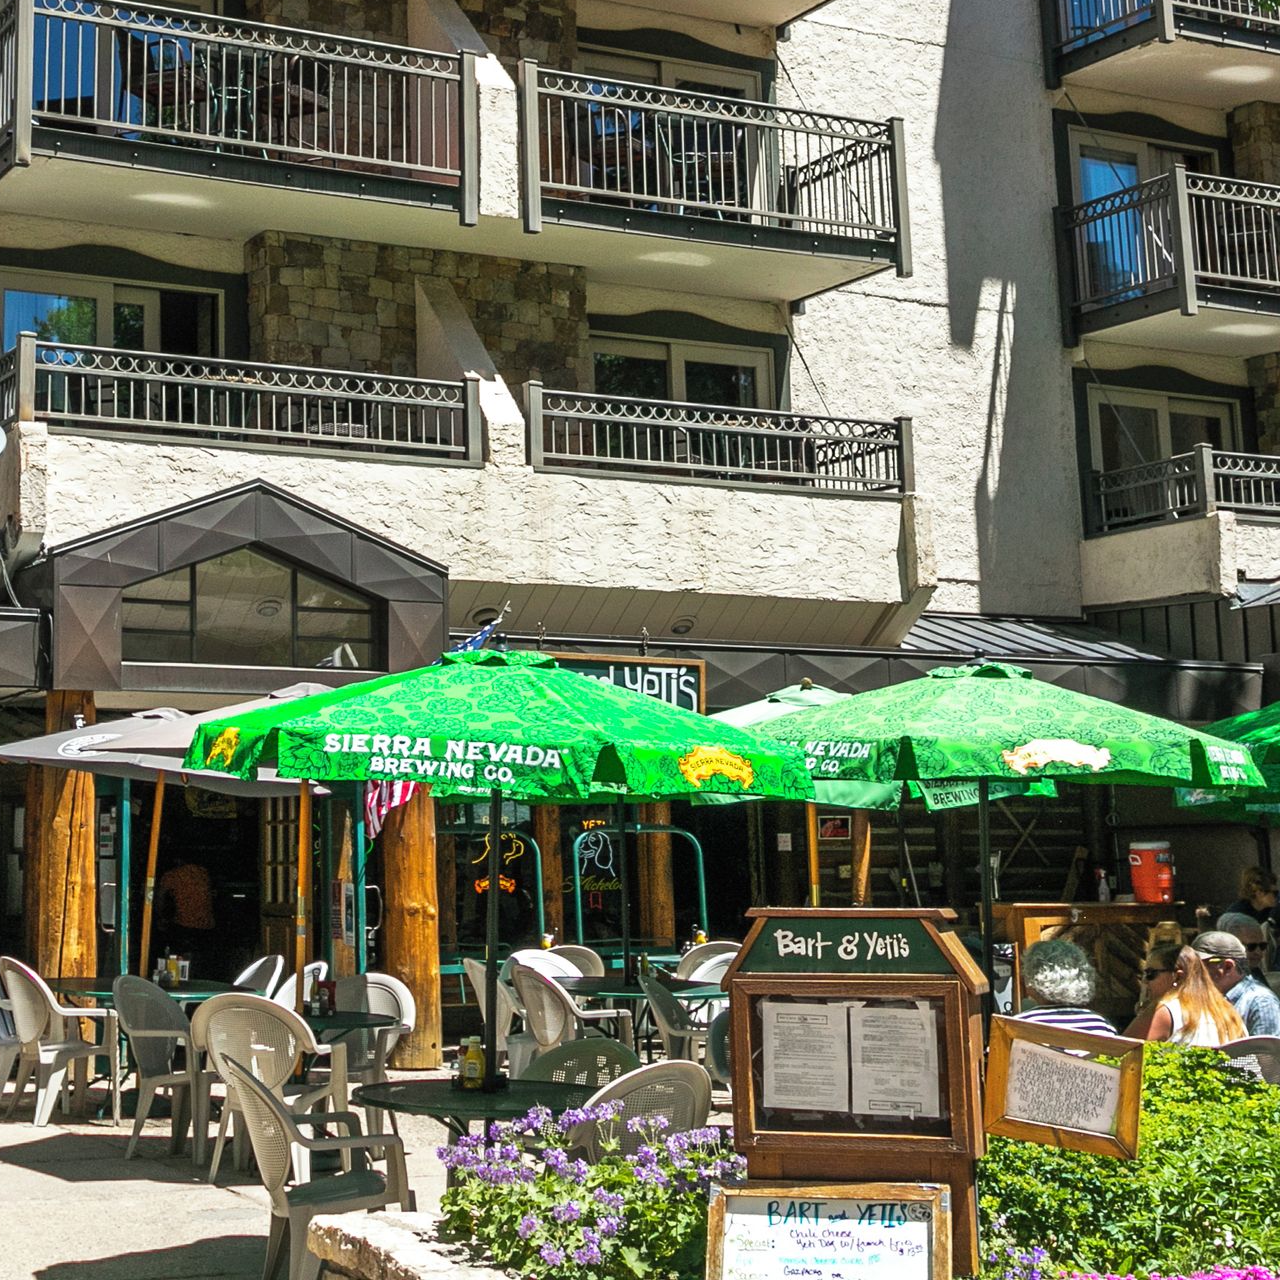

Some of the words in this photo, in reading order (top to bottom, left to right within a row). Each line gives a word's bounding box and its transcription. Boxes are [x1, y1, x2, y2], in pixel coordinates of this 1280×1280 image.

[324, 733, 431, 756] SIERRA
[445, 738, 561, 769] NEVADA
[804, 740, 871, 758] NEVADA
[370, 756, 475, 780] BREWING
[483, 765, 516, 784] CO.
[773, 928, 833, 960] Bart
[837, 932, 859, 960] &
[863, 931, 910, 961] Yeti's
[768, 1201, 827, 1225] BART
